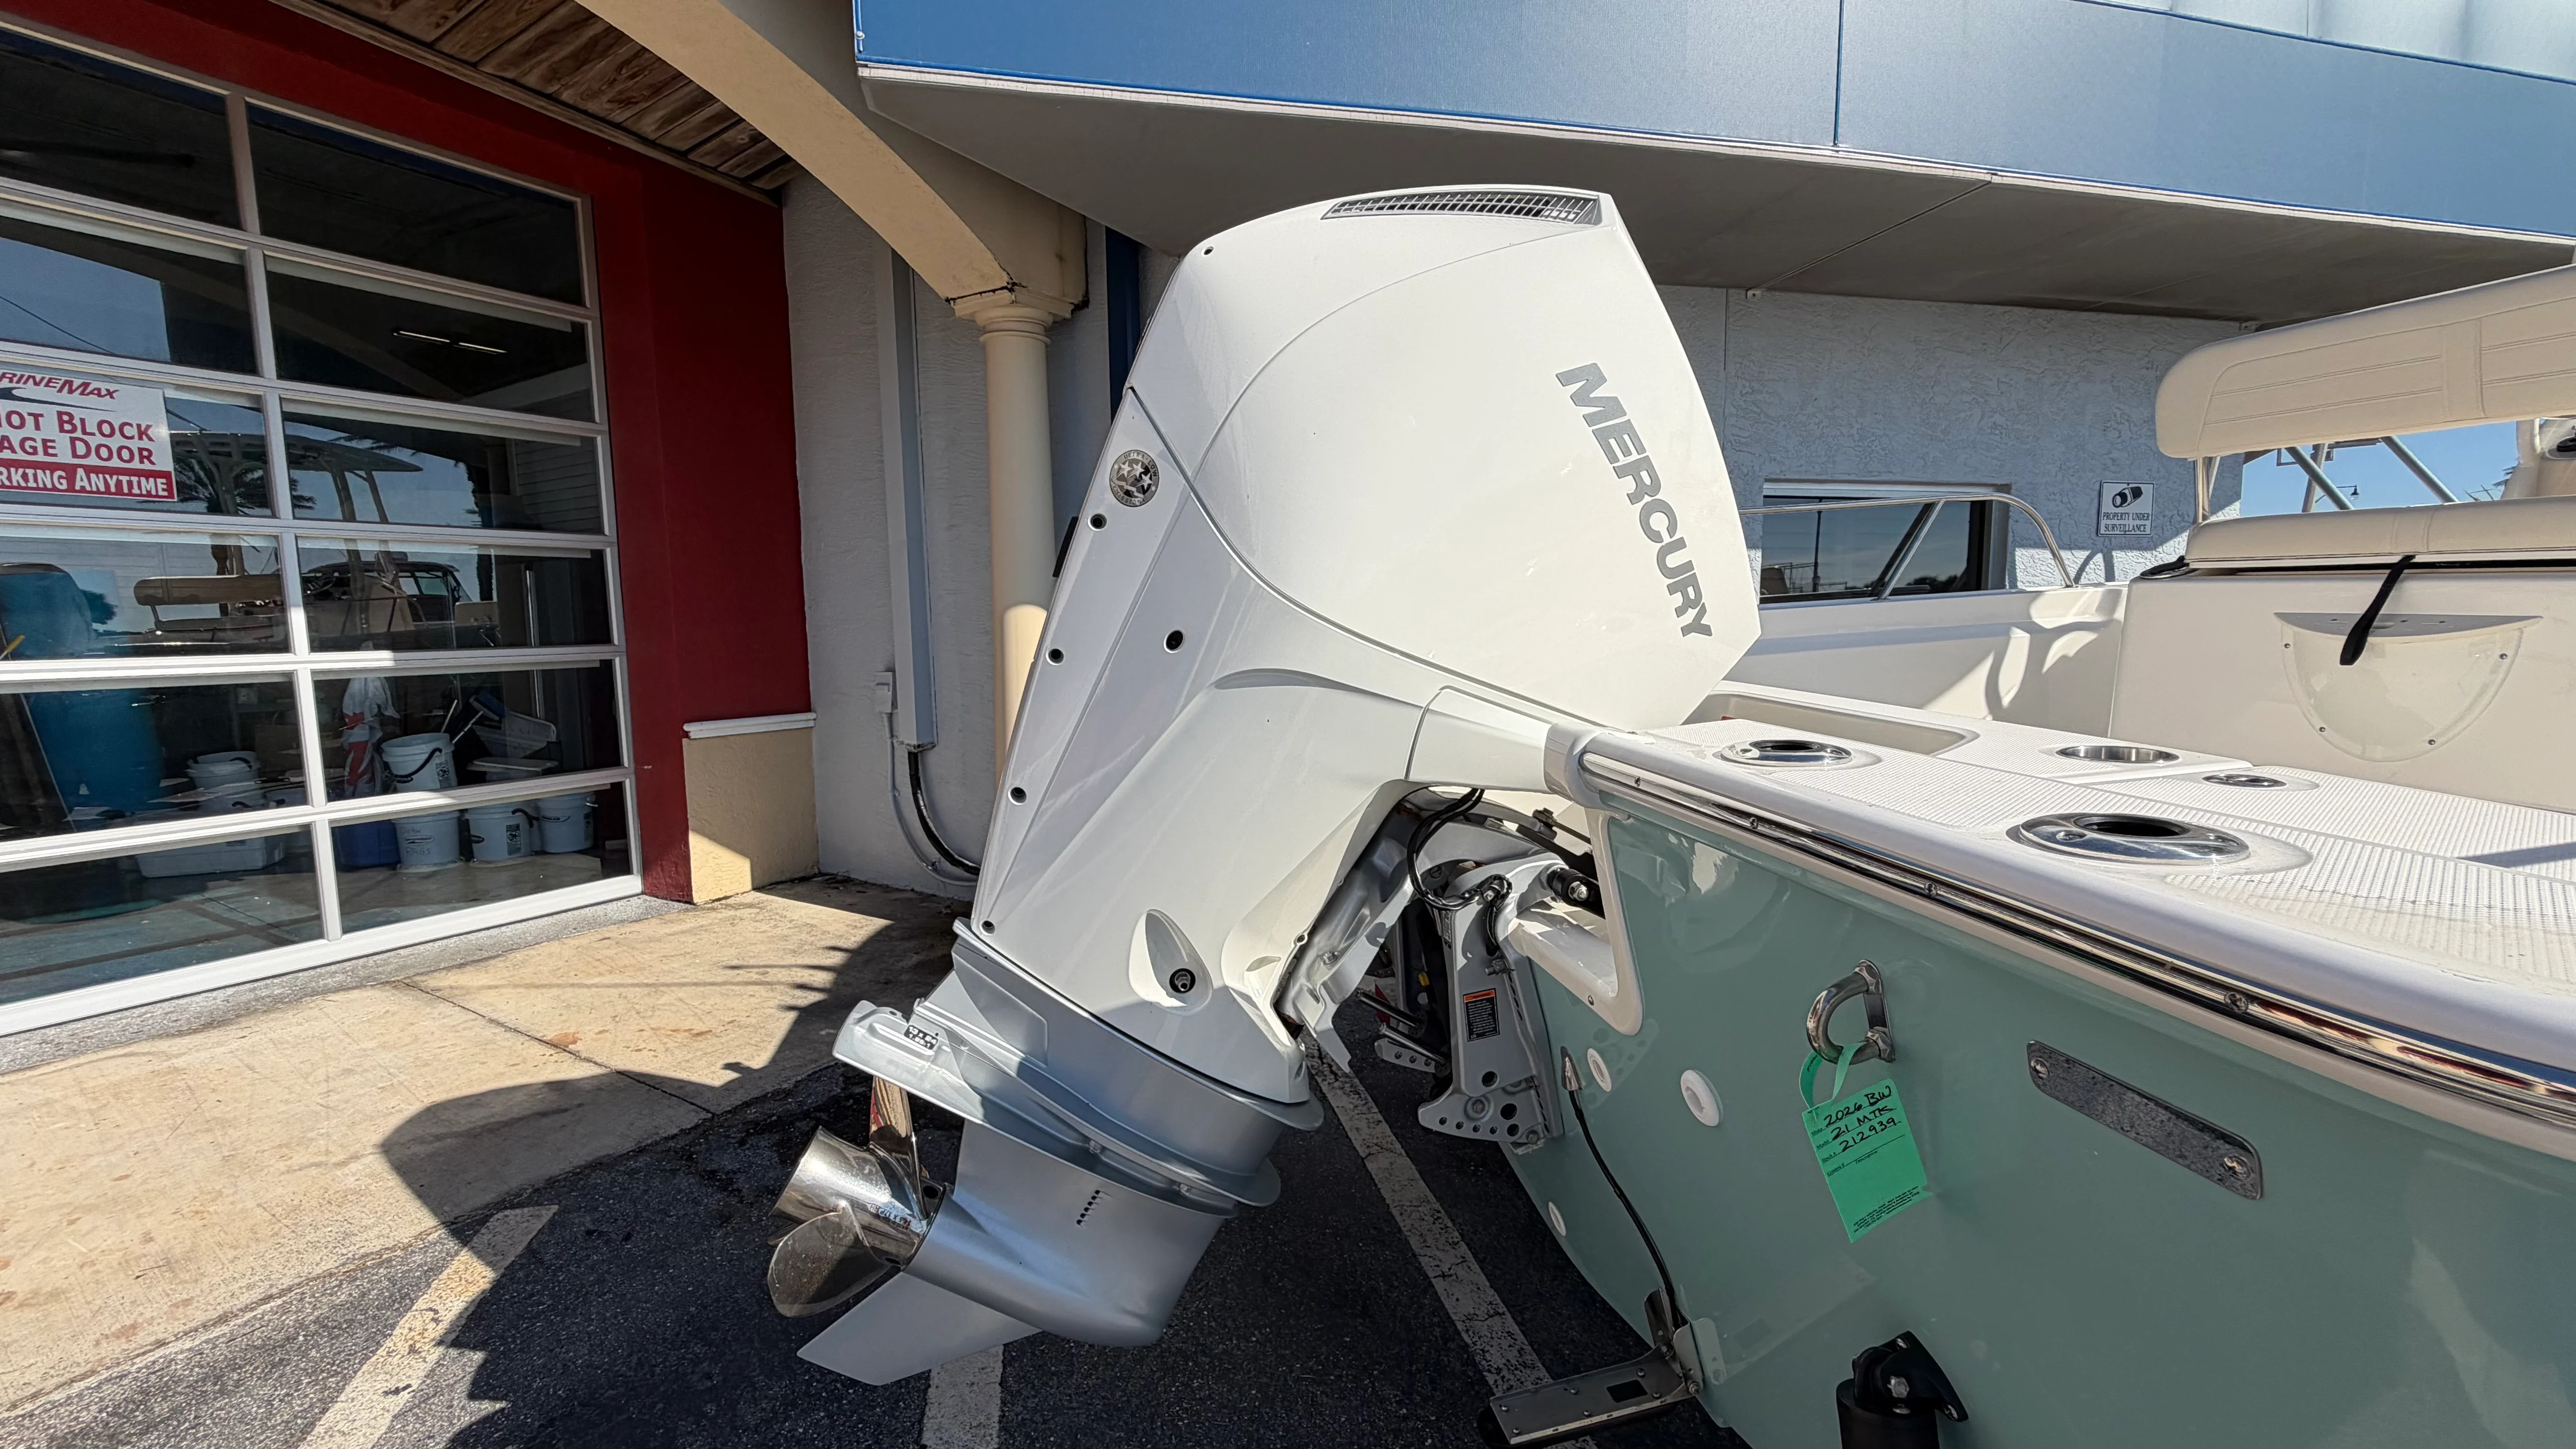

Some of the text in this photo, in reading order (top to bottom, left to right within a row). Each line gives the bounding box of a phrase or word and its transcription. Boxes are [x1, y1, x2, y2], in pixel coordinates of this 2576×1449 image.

[0, 410, 156, 442] OT BLOCK
[69, 436, 156, 465] DOOR
[75, 468, 168, 496] ANYTIME
[1555, 362, 1713, 638] MERCURY
[2103, 512, 2150, 521] PROPERTY UNDER
[2104, 523, 2147, 532] SURVEILLANCE
[405, 846, 431, 855] RAGS
[1823, 1102, 1862, 1128] 2026
[1831, 1123, 1850, 1141] 21
[1839, 1117, 1897, 1153] 212939
